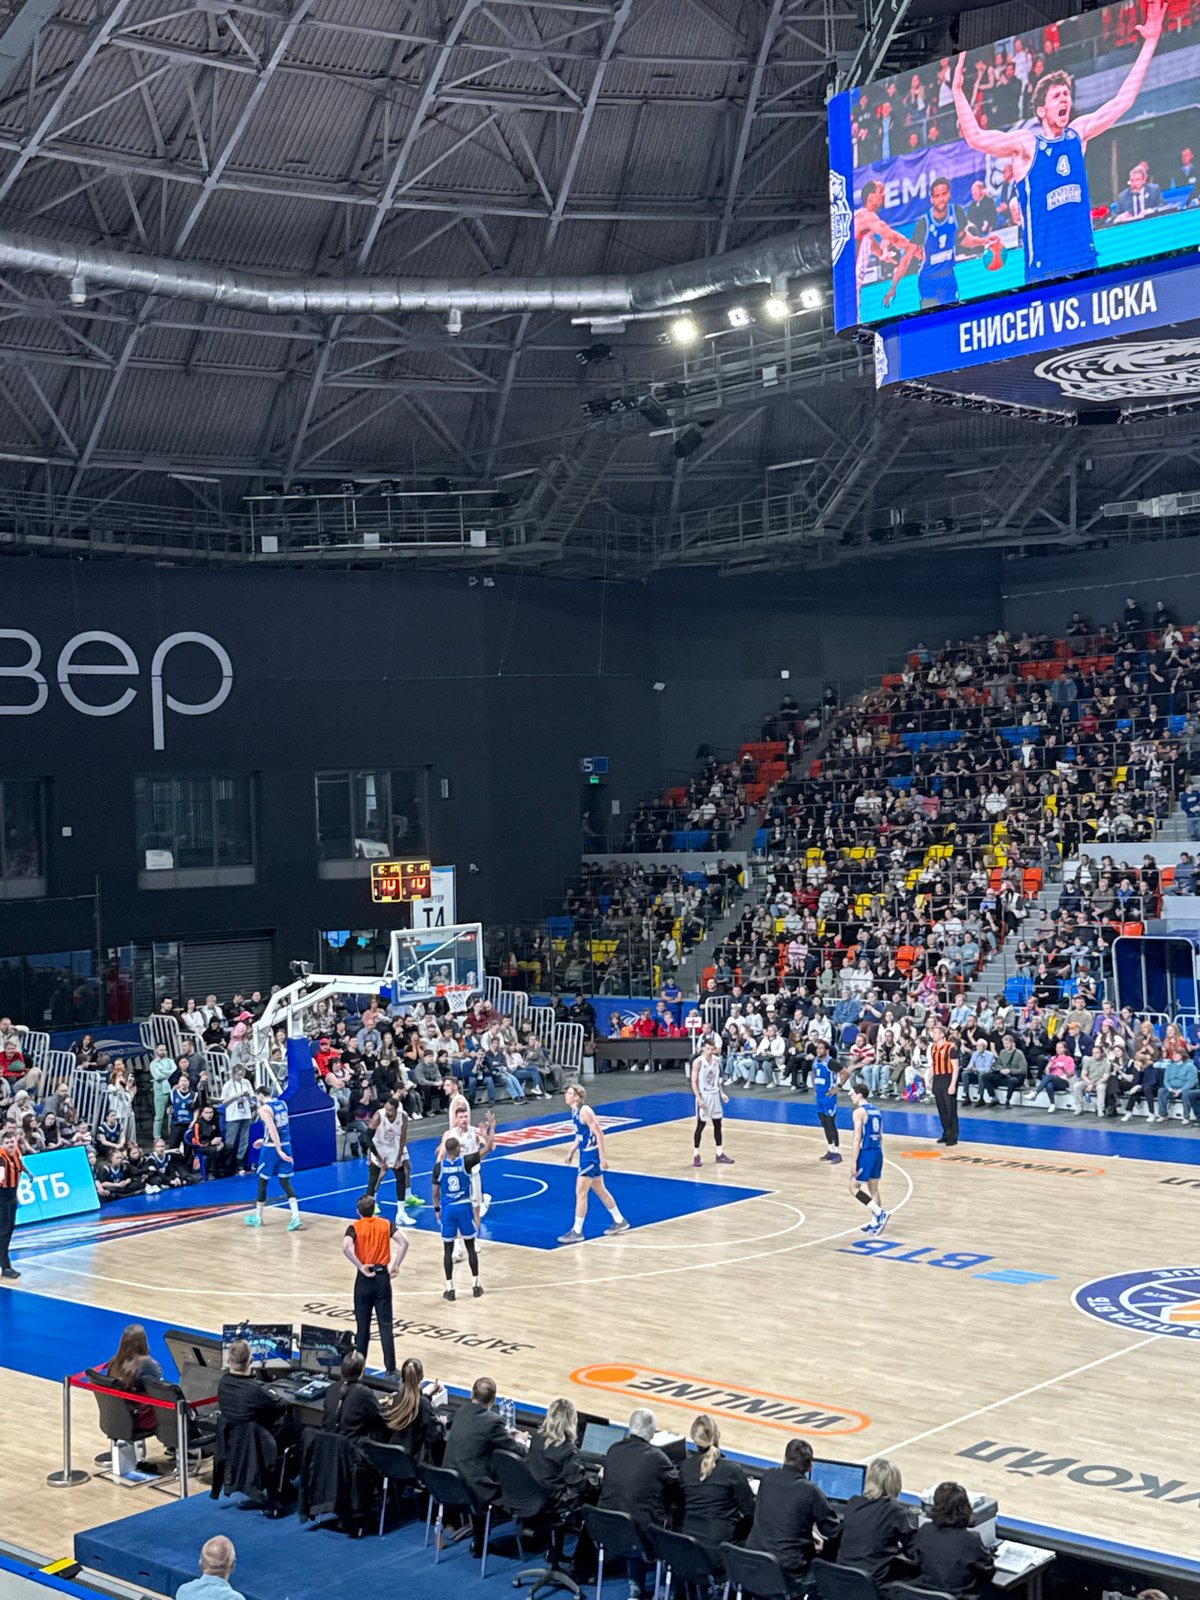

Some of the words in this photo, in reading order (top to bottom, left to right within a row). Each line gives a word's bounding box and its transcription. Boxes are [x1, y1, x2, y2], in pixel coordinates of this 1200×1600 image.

[1056, 155, 1071, 177] 4
[959, 301, 1044, 353] ЕНИСЕЙ
[1050, 298, 1087, 334] VS.
[1092, 280, 1157, 324] ЦСКА
[583, 758, 594, 772] 5
[942, 1154, 1086, 1175] WINLINE
[18, 1172, 70, 1206] ВТБ
[447, 1175, 460, 1192] 2
[836, 1239, 995, 1270] ВТБ
[1087, 1296, 1118, 1313] ВТБ
[626, 1377, 846, 1428] WINLINE
